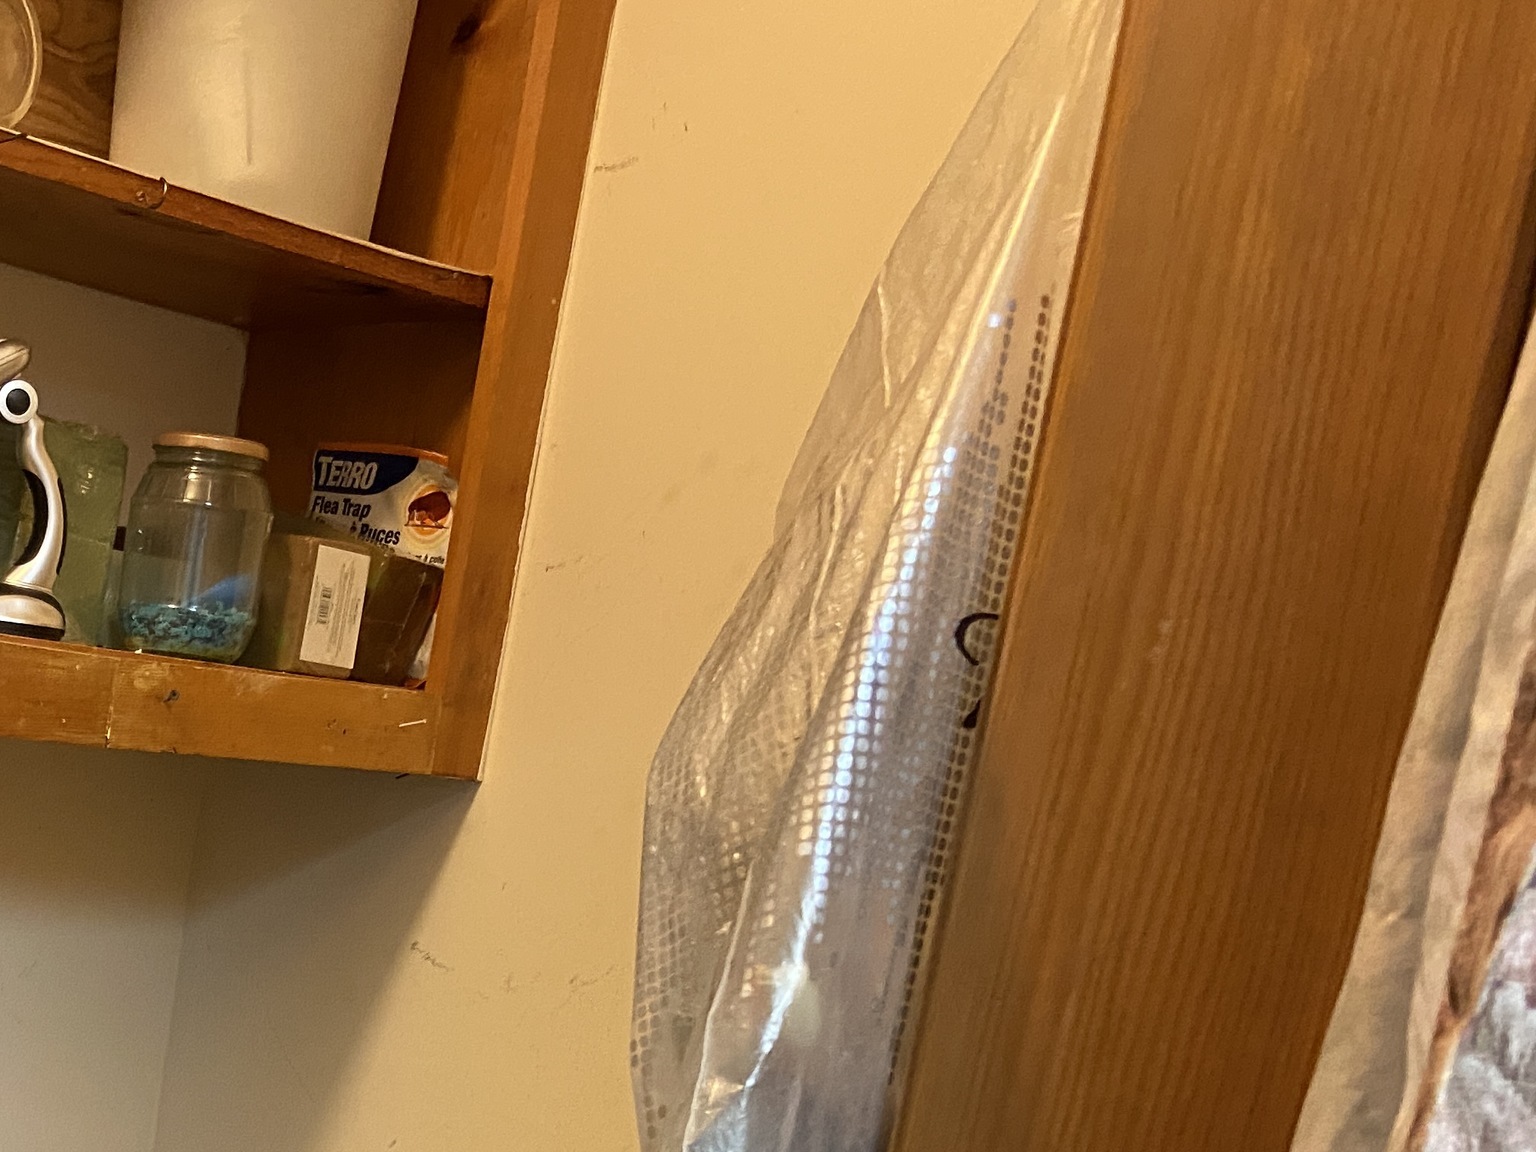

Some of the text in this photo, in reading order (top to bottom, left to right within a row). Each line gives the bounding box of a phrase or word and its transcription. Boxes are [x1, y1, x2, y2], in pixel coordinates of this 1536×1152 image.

[317, 456, 378, 490] TERRO
[312, 495, 339, 516] Flea
[342, 498, 371, 521] Trap
